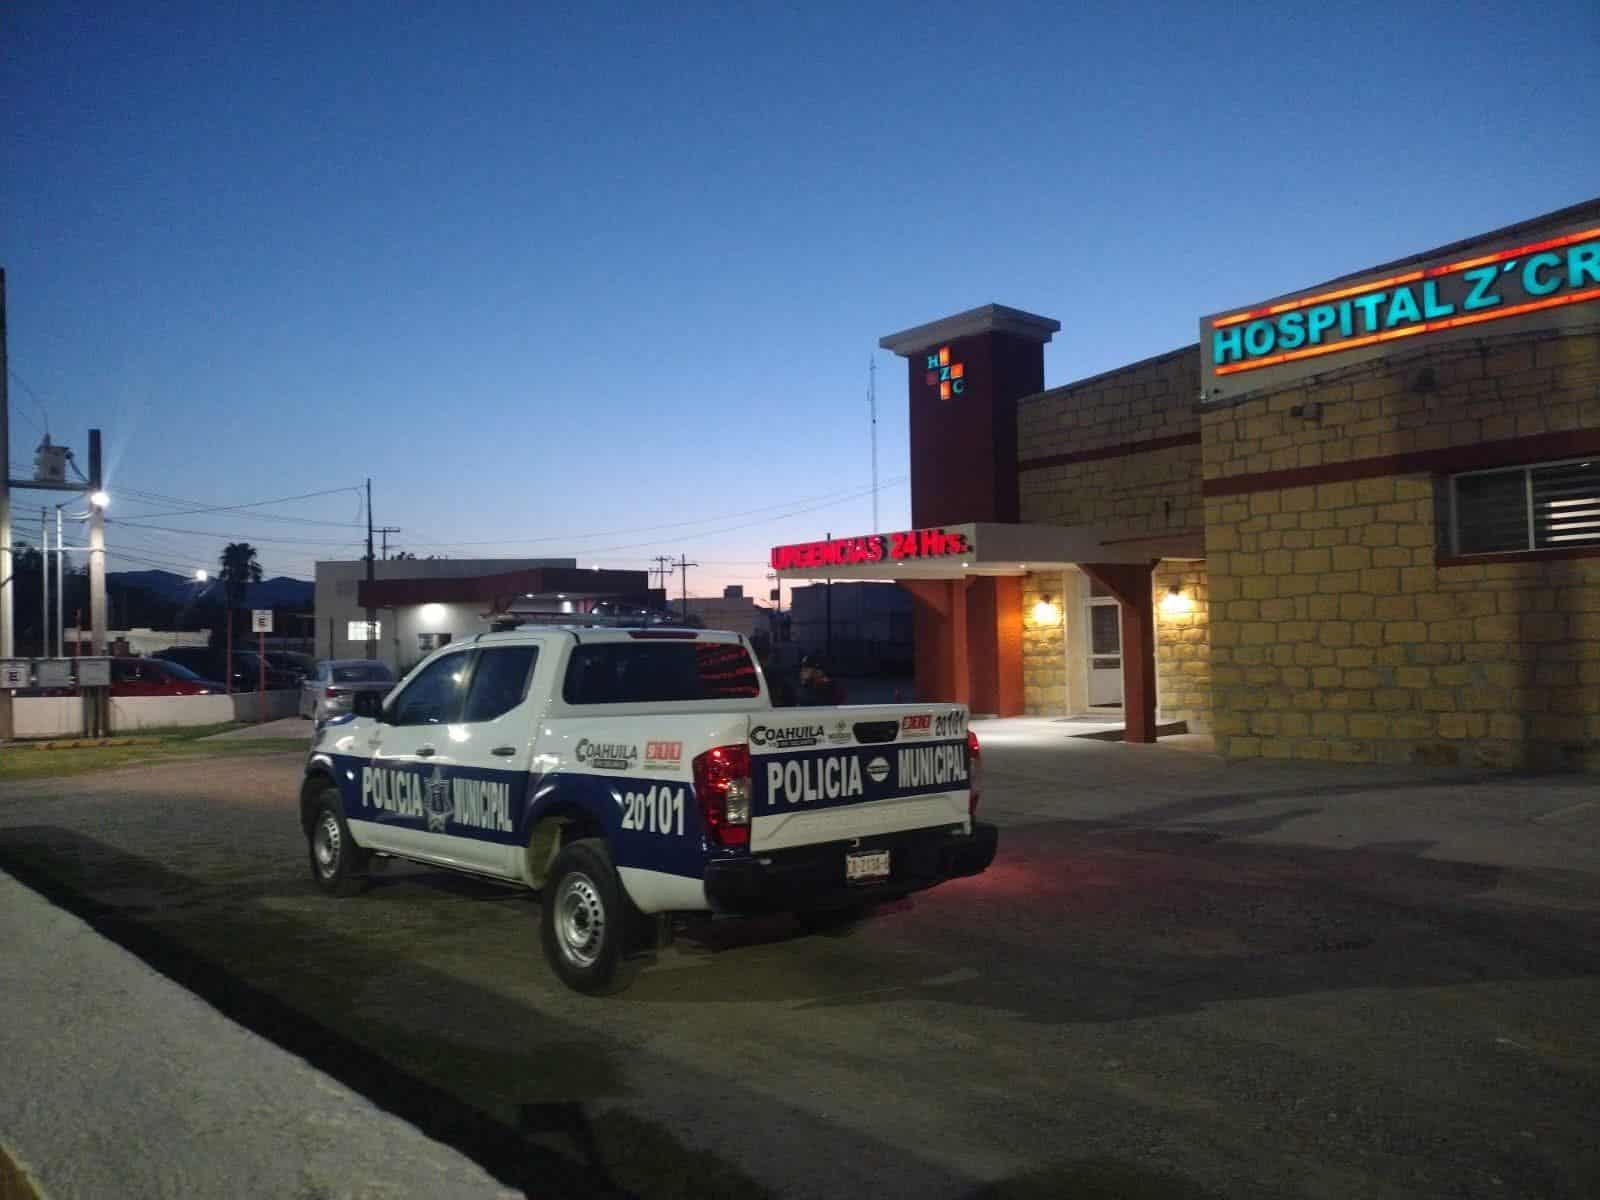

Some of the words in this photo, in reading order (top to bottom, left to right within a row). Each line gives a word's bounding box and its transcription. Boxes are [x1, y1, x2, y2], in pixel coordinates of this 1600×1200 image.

[1213, 280, 1454, 364] HOSPITAL
[928, 355, 938, 369] H
[940, 366, 949, 381] Z
[953, 379, 964, 393] C
[362, 765, 423, 817] POLICIA
[454, 775, 513, 832] MUNICIPAL
[768, 756, 864, 805] POLICIA
[899, 744, 968, 788] MUNICIPAL
[621, 785, 685, 836] 20101
